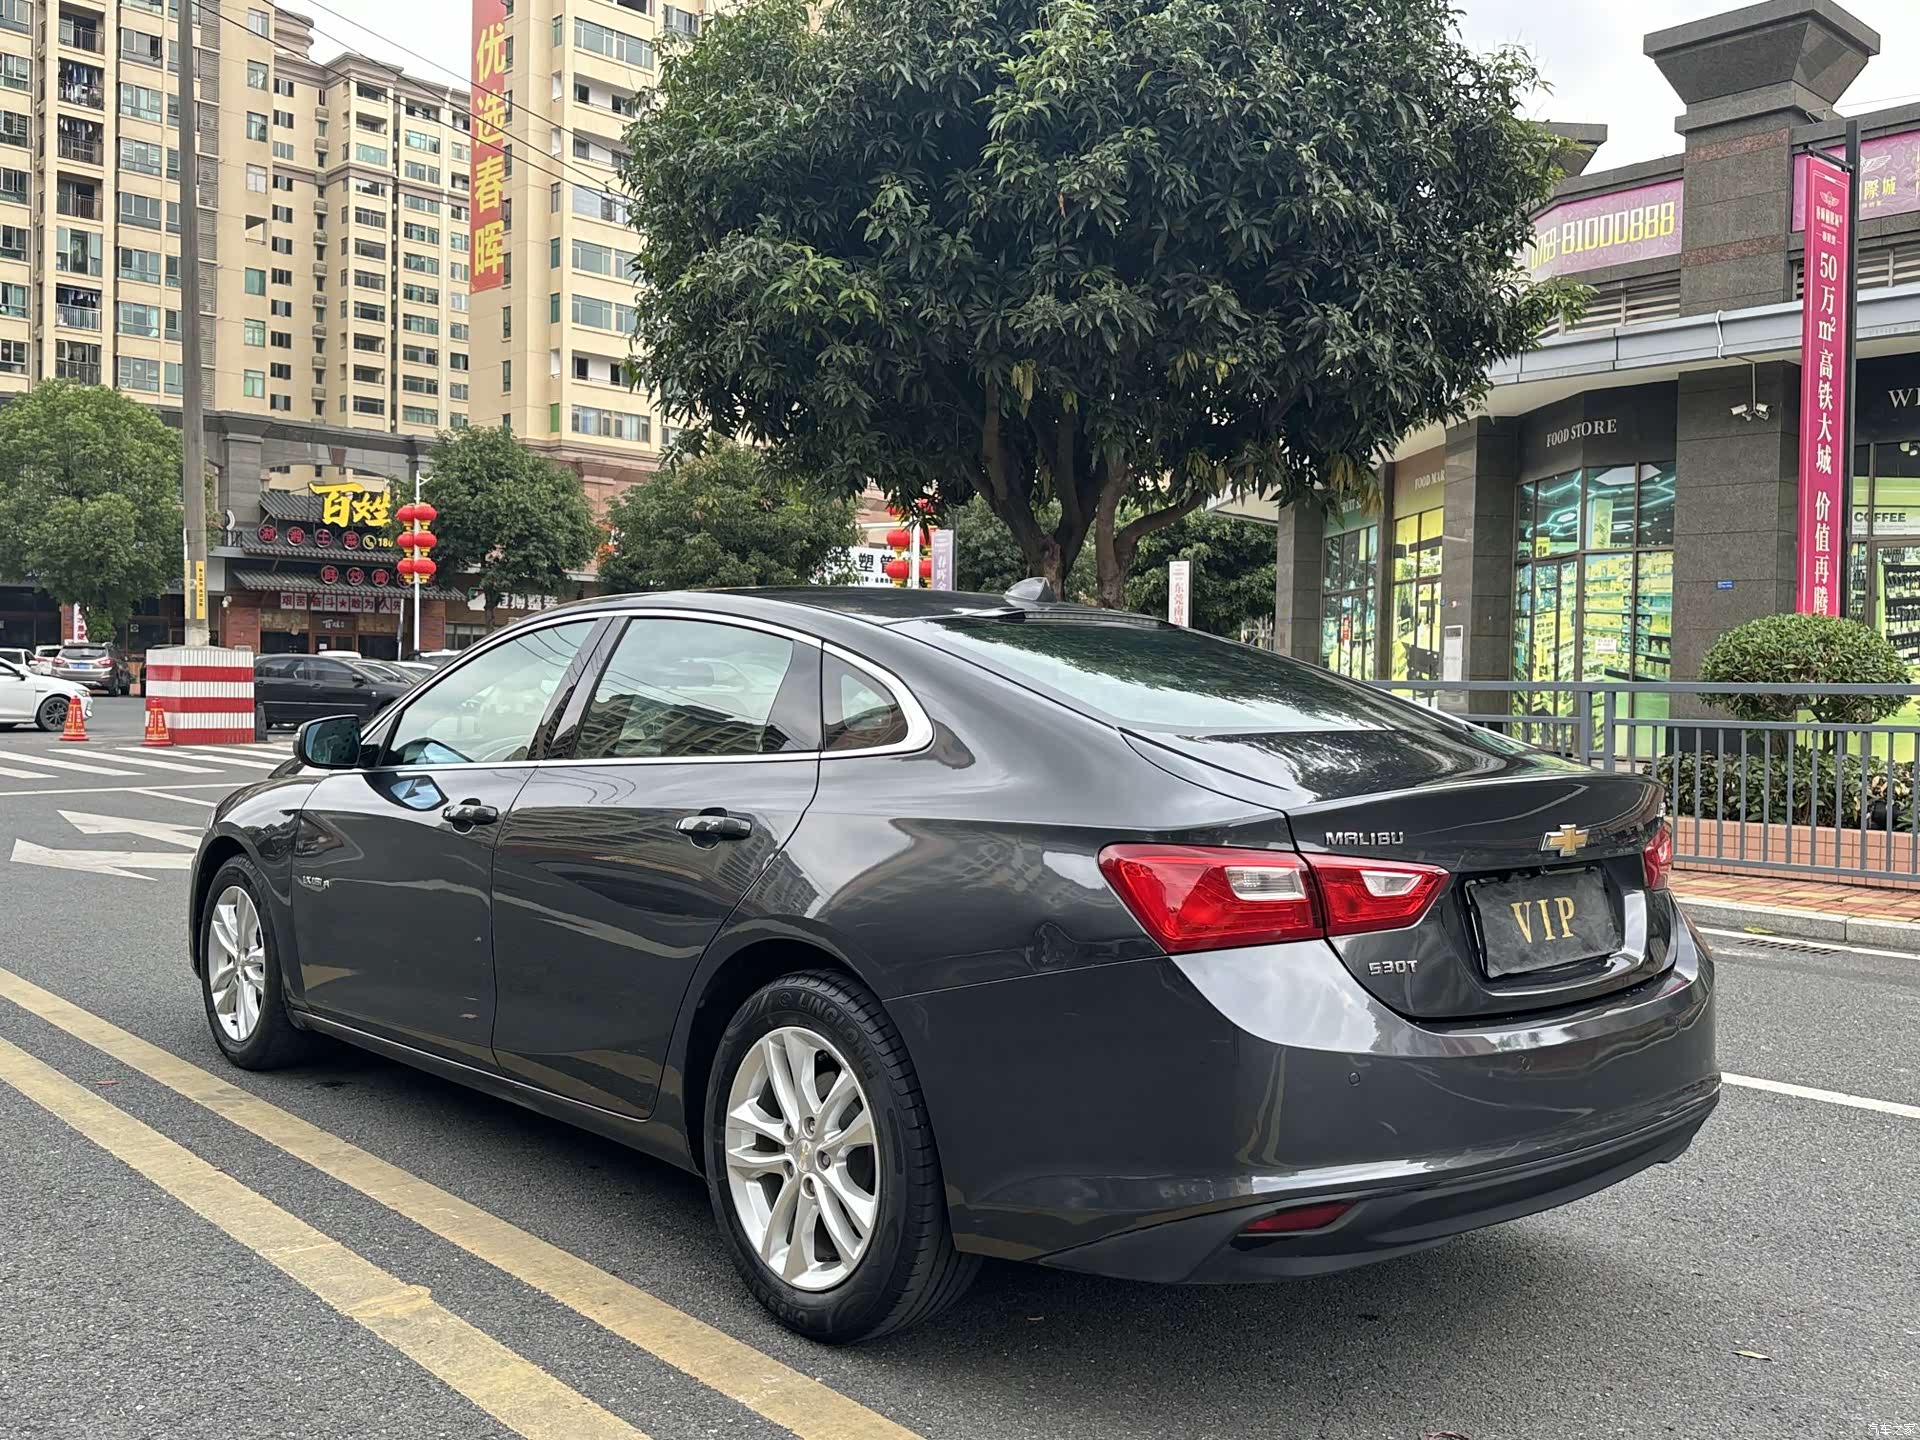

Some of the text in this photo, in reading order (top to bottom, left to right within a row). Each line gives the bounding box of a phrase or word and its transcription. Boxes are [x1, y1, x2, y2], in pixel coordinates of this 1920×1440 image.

[474, 22, 505, 277] 优选春晖
[1546, 418, 1617, 447] FOOD STORE
[308, 482, 391, 528] 百姓
[1854, 512, 1906, 523] COFFEE
[1325, 831, 1404, 846] MALIBU
[1510, 896, 1575, 944] VIP
[1368, 959, 1418, 975] 530T
